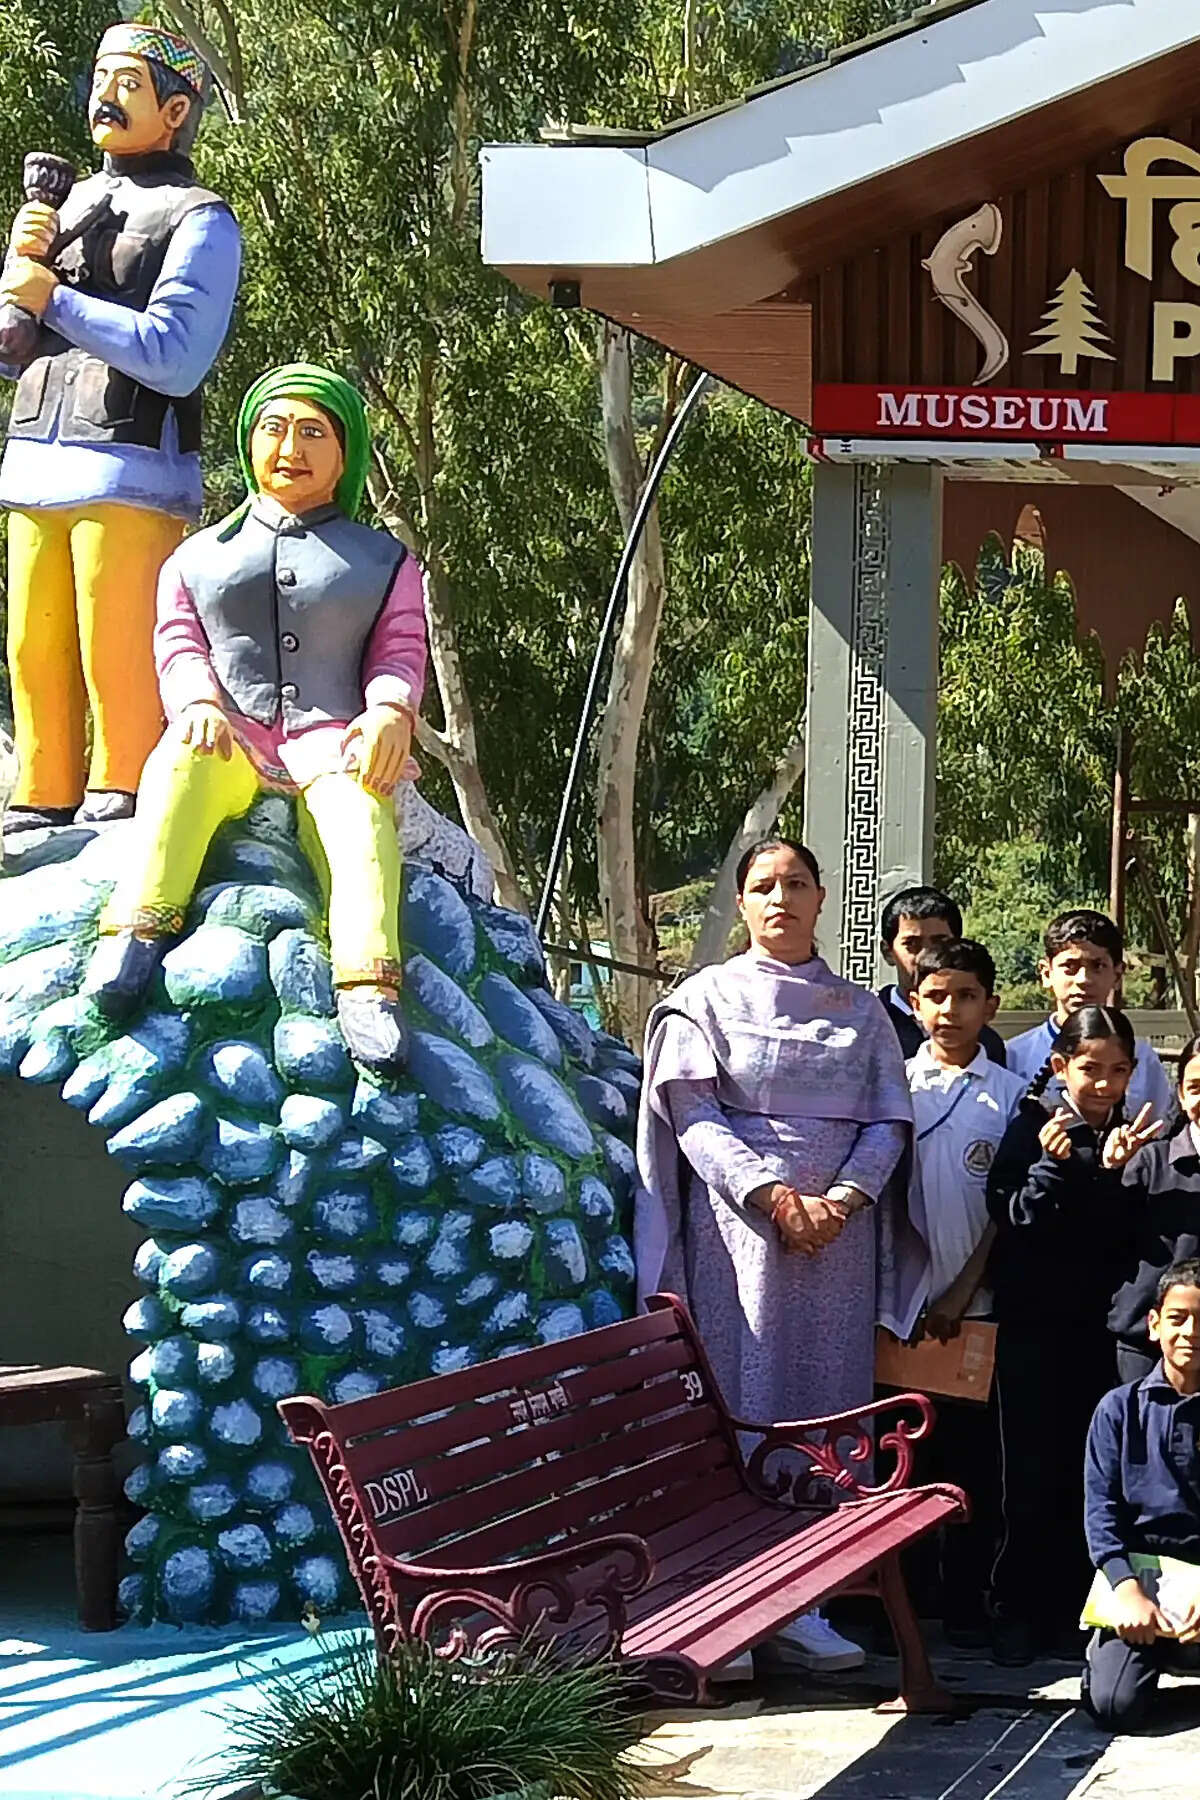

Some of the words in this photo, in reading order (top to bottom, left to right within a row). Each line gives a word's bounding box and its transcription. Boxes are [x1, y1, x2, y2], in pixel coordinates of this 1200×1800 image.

[877, 393, 1108, 432] MUSEUM
[680, 1370, 703, 1401] 39
[363, 1468, 429, 1518] DSPL
